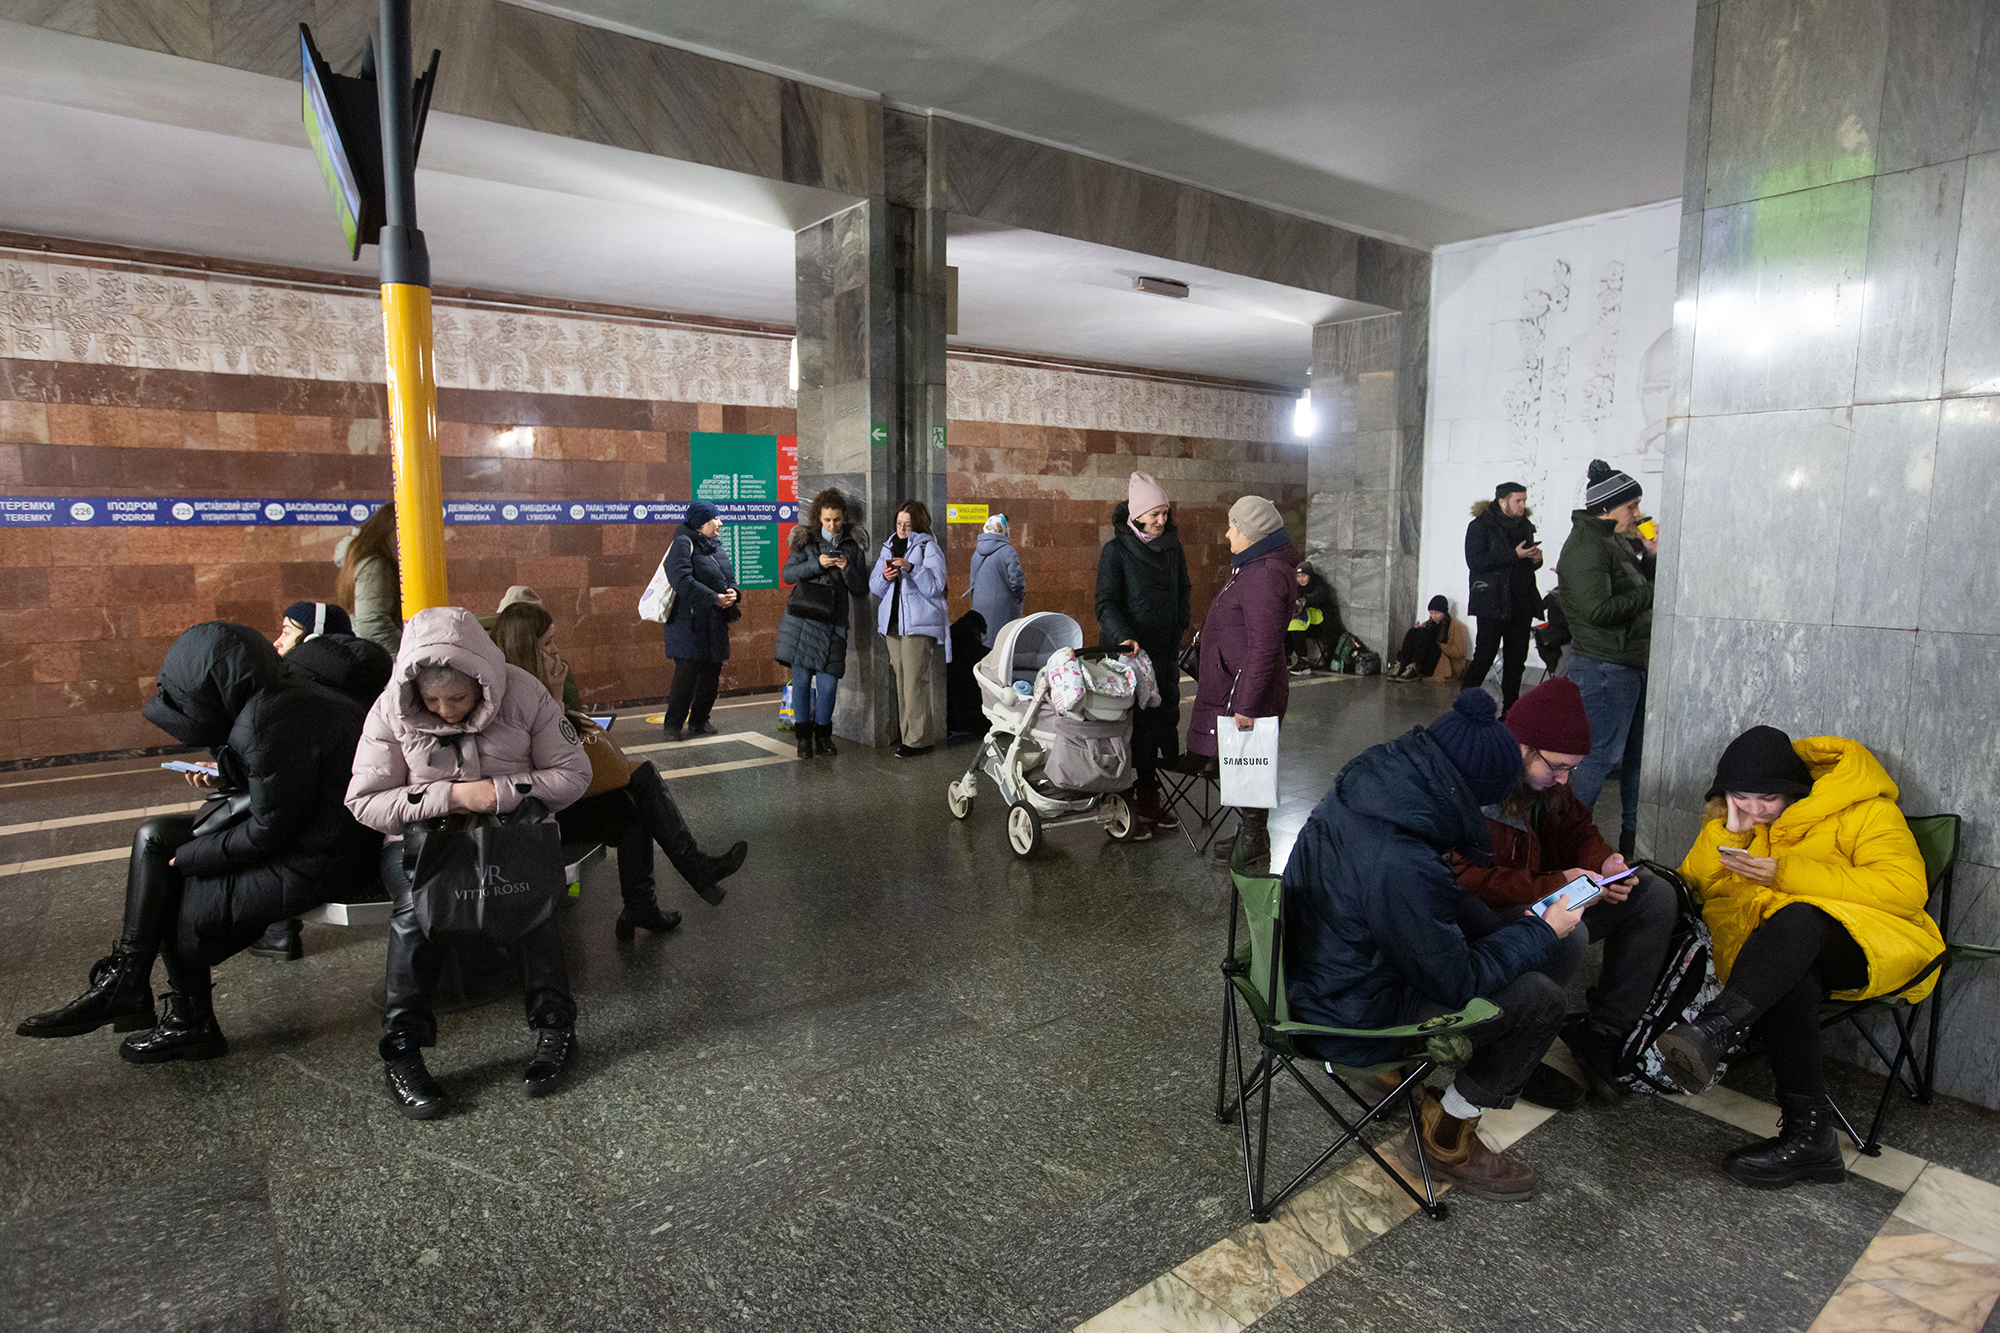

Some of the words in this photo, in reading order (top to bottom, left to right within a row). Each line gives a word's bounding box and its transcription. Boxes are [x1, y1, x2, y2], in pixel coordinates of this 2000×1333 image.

[0, 501, 55, 511] ТЕРЕМКИ
[107, 501, 158, 511] ІПОДРОМ
[75, 507, 92, 516] 226
[175, 507, 192, 516] 225
[268, 507, 284, 516] 224
[4, 513, 52, 522] TEREMKY
[112, 513, 155, 522] IPODROM
[1223, 757, 1269, 766] SAMSUNG
[454, 889, 489, 900] VITTO
[494, 882, 530, 896] ROSSI
